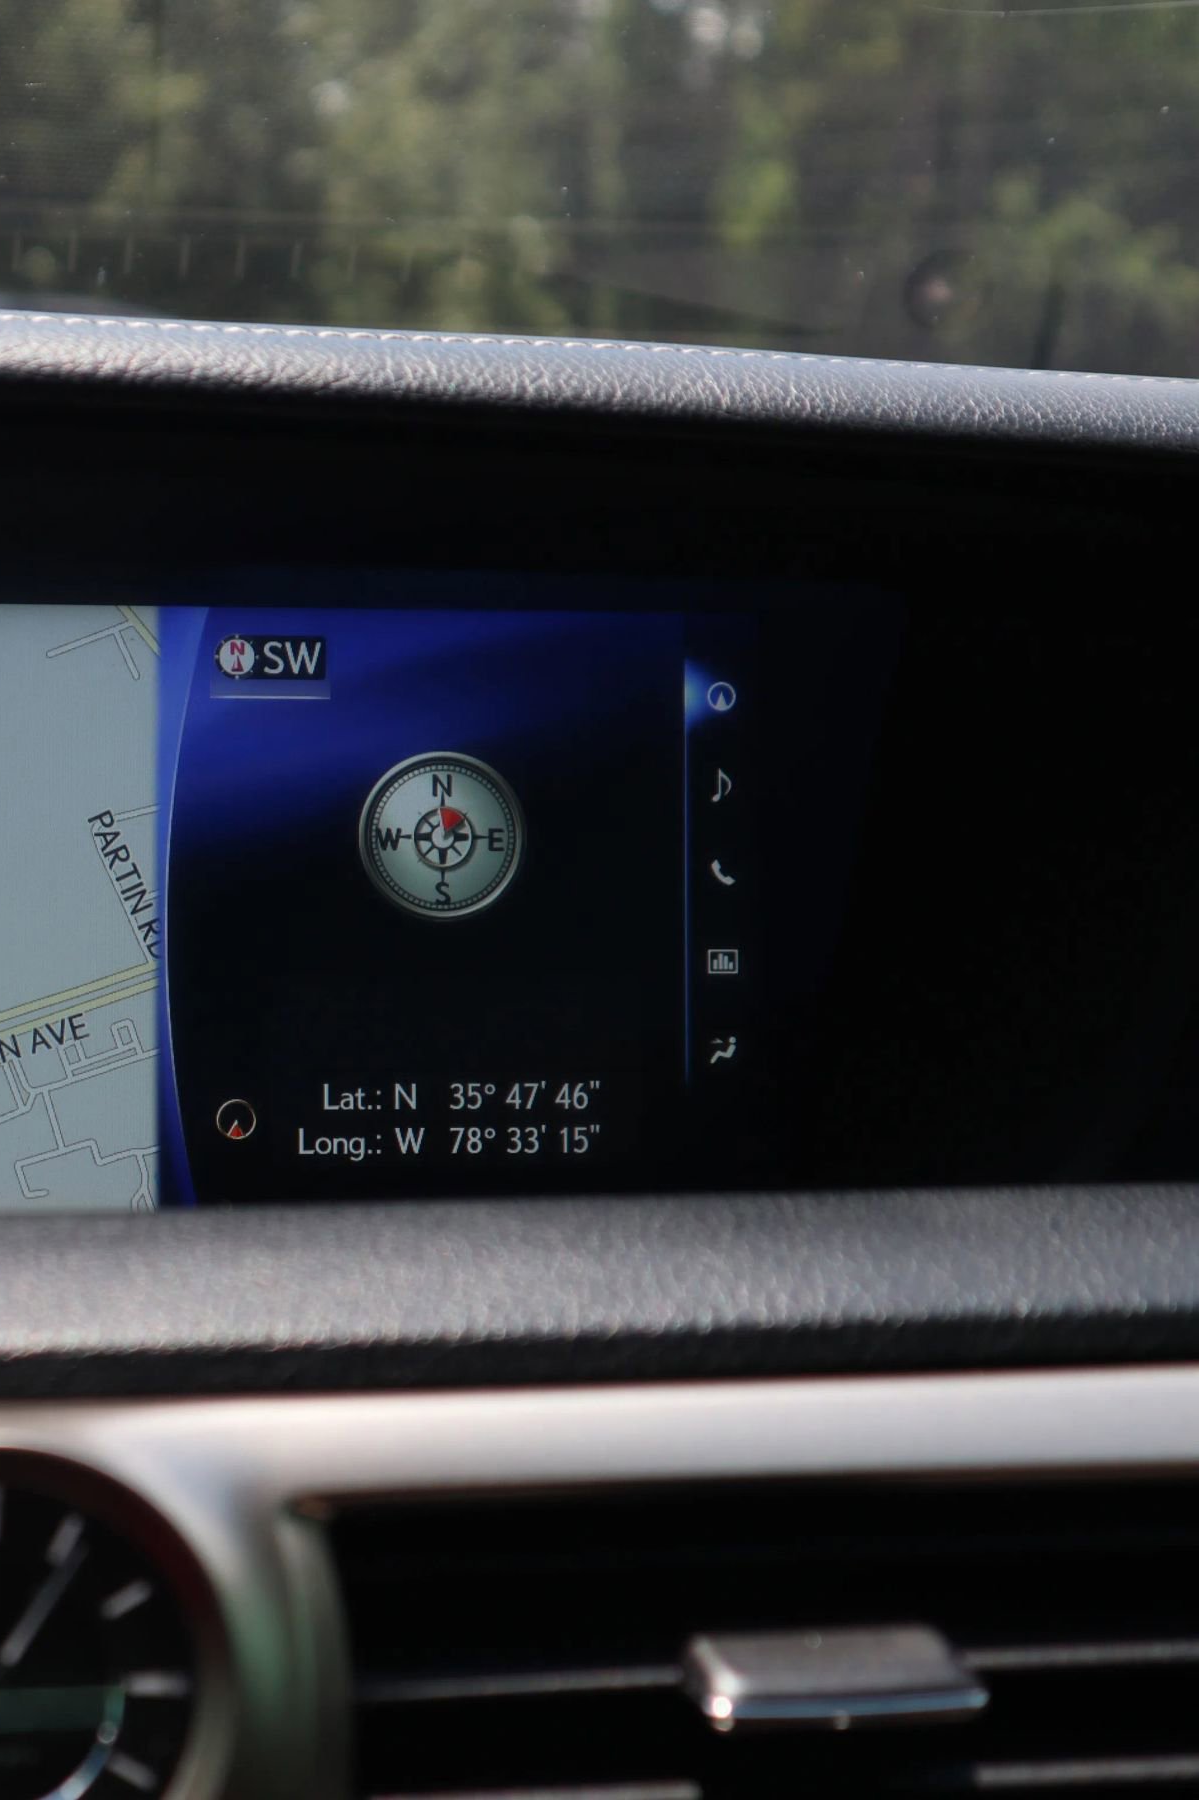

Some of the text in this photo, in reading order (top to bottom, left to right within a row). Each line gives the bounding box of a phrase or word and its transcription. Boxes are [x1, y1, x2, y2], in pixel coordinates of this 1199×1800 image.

[263, 641, 321, 675] SW
[432, 774, 452, 797] N
[377, 828, 401, 851] W
[488, 828, 505, 851] E
[87, 809, 153, 915] PARTIN
[435, 881, 450, 904] S
[31, 1013, 90, 1054] AVE
[323, 1083, 382, 1111] Lat.:
[394, 1083, 418, 1110] N
[449, 1083, 496, 1110] 35°
[298, 1127, 382, 1161] Long.:
[395, 1127, 425, 1154] W
[449, 1127, 496, 1154] 78°
